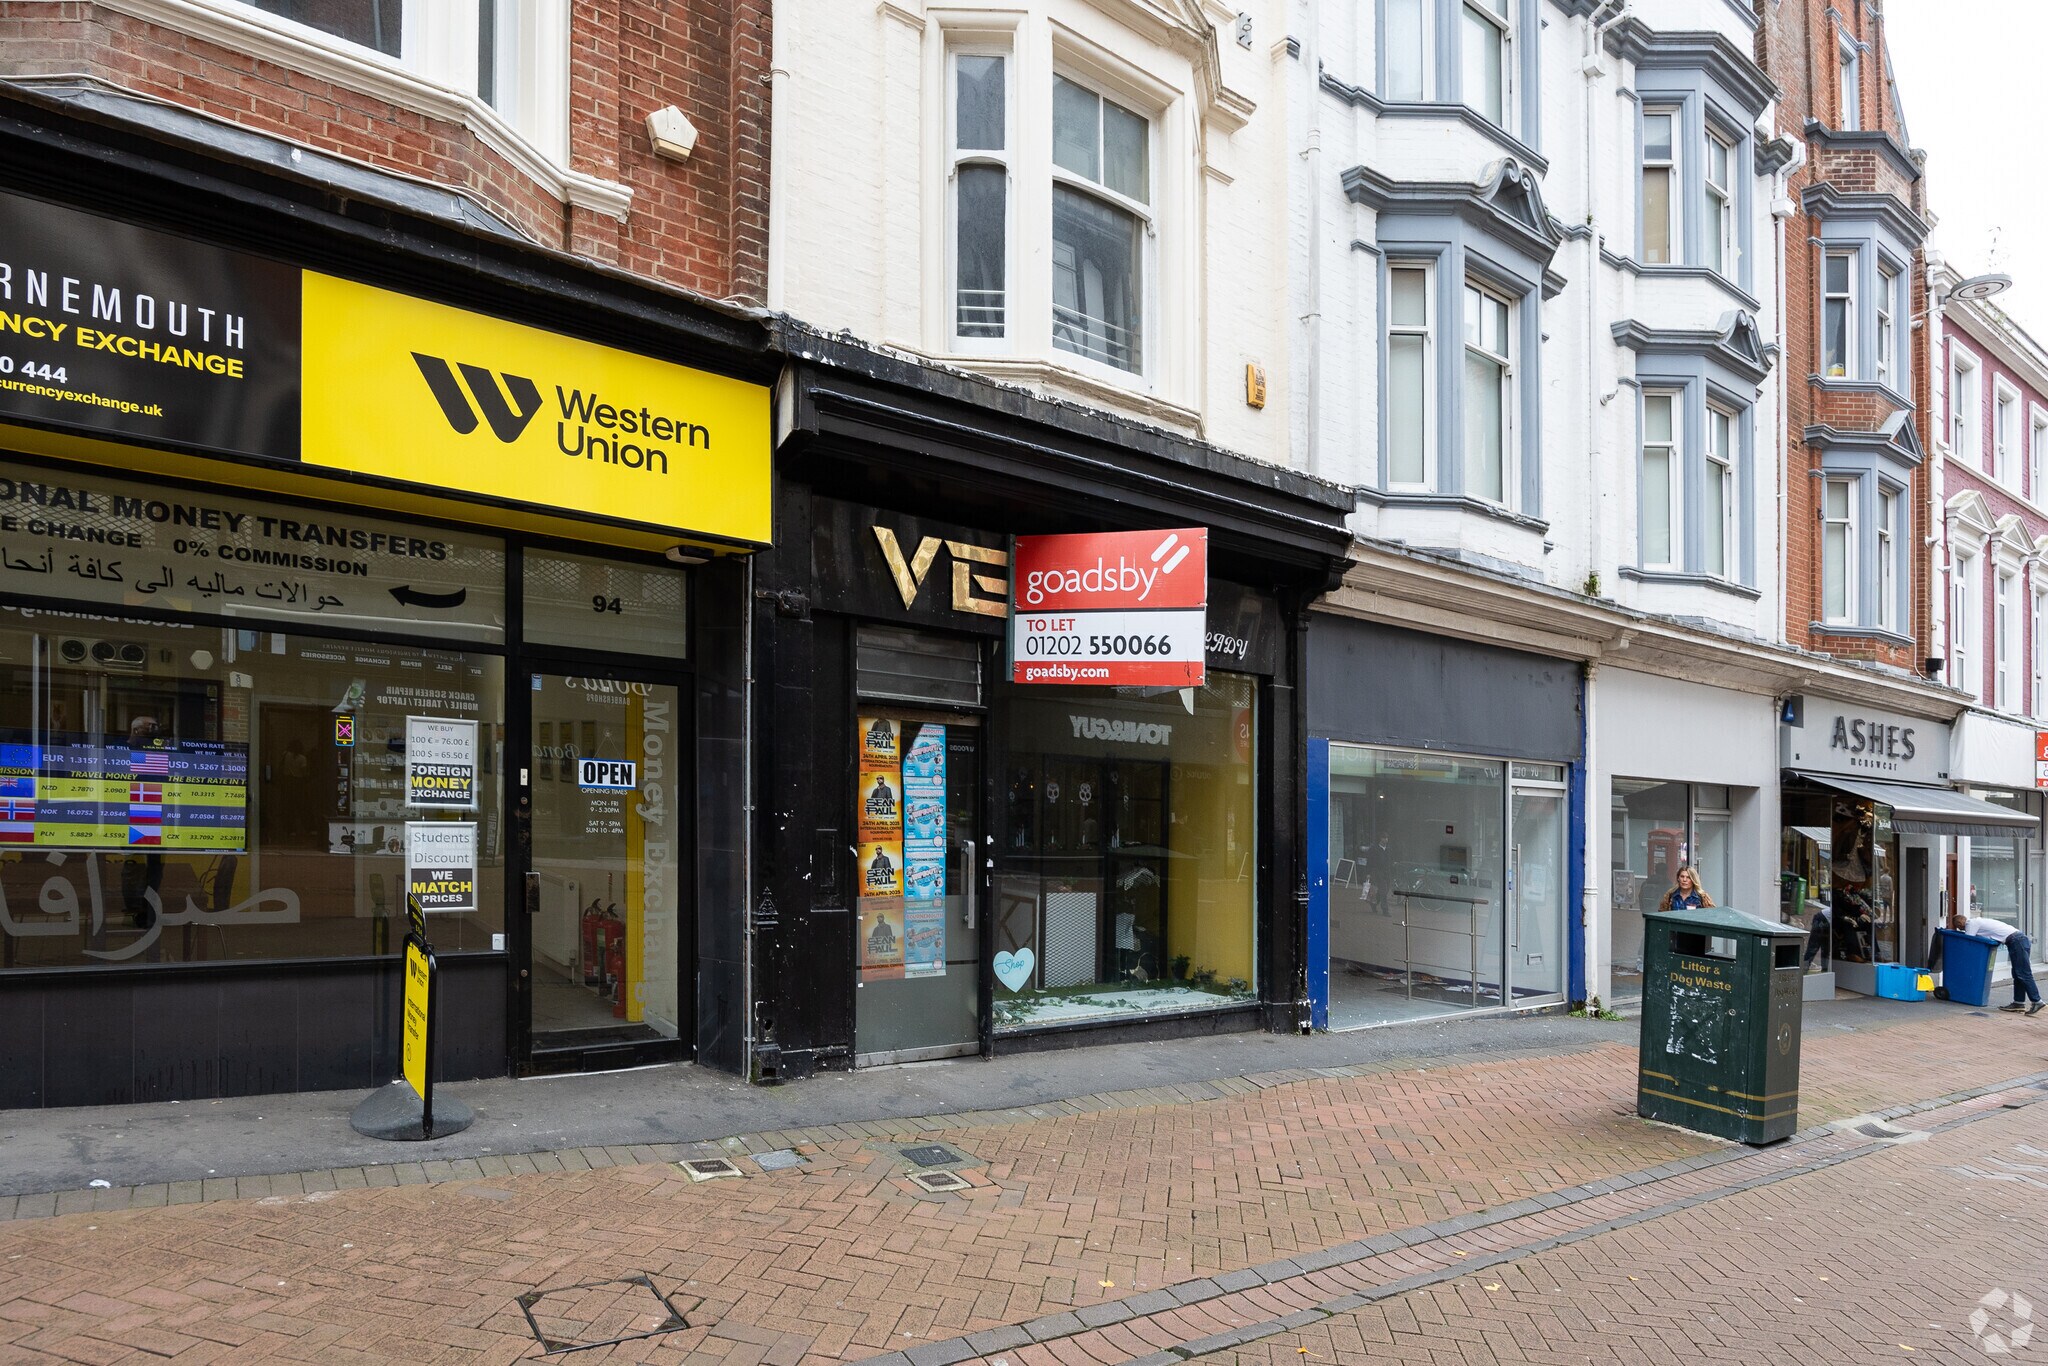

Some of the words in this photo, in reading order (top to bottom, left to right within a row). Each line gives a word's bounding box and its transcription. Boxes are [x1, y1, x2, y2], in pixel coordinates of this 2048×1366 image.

[0, 262, 244, 350] RNEMOUTH
[0, 310, 68, 342] NCY
[76, 326, 244, 379] EXCHANGE
[21, 361, 68, 384] 444
[0, 379, 163, 417] urrencyexchange.uk
[556, 385, 710, 449] Western
[557, 422, 668, 474] Union
[0, 478, 99, 513] ONAL
[114, 495, 245, 533] MONEY
[257, 516, 447, 561] TRANSFERS
[28, 518, 142, 549] CHANGE
[173, 538, 210, 558] 0%
[217, 544, 368, 577] COMMISSION
[1026, 556, 1159, 605] goadsby
[592, 595, 622, 615] 94
[1026, 619, 1047, 632] TO
[1051, 618, 1076, 632] LET
[1026, 635, 1082, 656] 01202
[1089, 634, 1172, 656] 550066
[1026, 663, 1110, 681] goadsby.com
[411, 736, 426, 744] 100
[441, 737, 462, 746] 76.00
[866, 731, 895, 741] SEAN
[1832, 715, 1916, 760] ASHES
[181, 741, 208, 749] TODAYS
[865, 740, 896, 750] PAUL
[42, 754, 64, 763] EUR
[104, 758, 131, 766] 1.1200
[411, 750, 426, 758] 100
[441, 751, 462, 759] 65.50
[168, 761, 189, 769] USD
[635, 699, 670, 827] Money
[1850, 757, 1897, 771] menswear
[70, 770, 103, 779] TRAVEL
[105, 772, 138, 780] MONEY
[411, 765, 471, 777] FOREIGN
[584, 761, 632, 785] OPEN
[411, 776, 471, 790] MONEY
[411, 789, 471, 799] EXCHANGE
[866, 798, 895, 807] SEAN
[865, 806, 897, 815] PAUL
[413, 832, 470, 843] Students
[414, 852, 470, 863] Discount
[431, 871, 453, 880] WE
[866, 867, 895, 877] SEAN
[412, 881, 472, 894] MATCH
[866, 877, 897, 887] PAUL
[422, 894, 463, 903] PRICES
[1681, 960, 1711, 974] Litter
[1713, 967, 1721, 975] &
[1670, 972, 1693, 986] Dog
[1695, 977, 1732, 991] Waste
